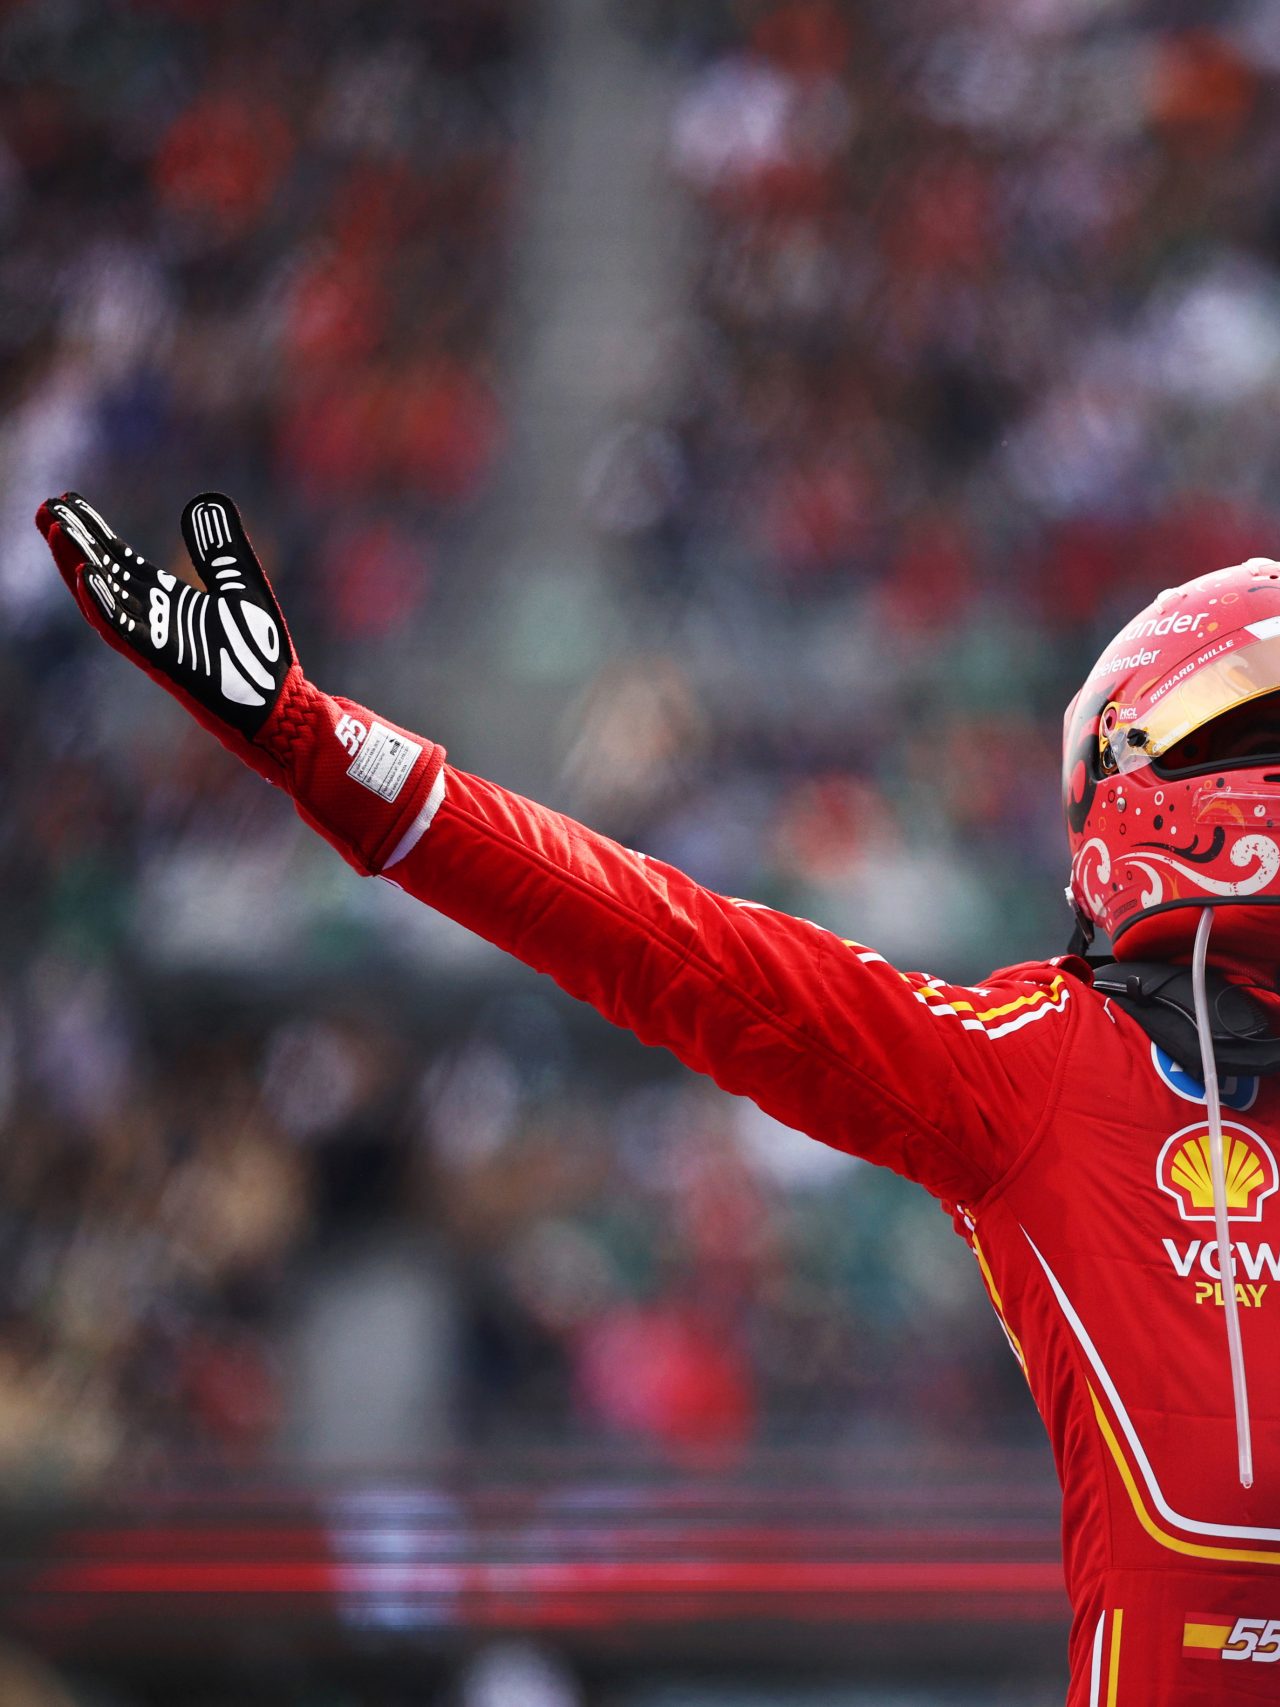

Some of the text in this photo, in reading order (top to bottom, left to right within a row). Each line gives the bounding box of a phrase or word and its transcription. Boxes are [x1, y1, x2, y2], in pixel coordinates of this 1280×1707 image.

[1120, 611, 1209, 642] ander
[1099, 647, 1161, 677] efender
[1149, 639, 1234, 703] RICHARD MILLE
[1120, 708, 1138, 717] HCL
[334, 713, 367, 757] 55
[1195, 1281, 1268, 1308] PLAY
